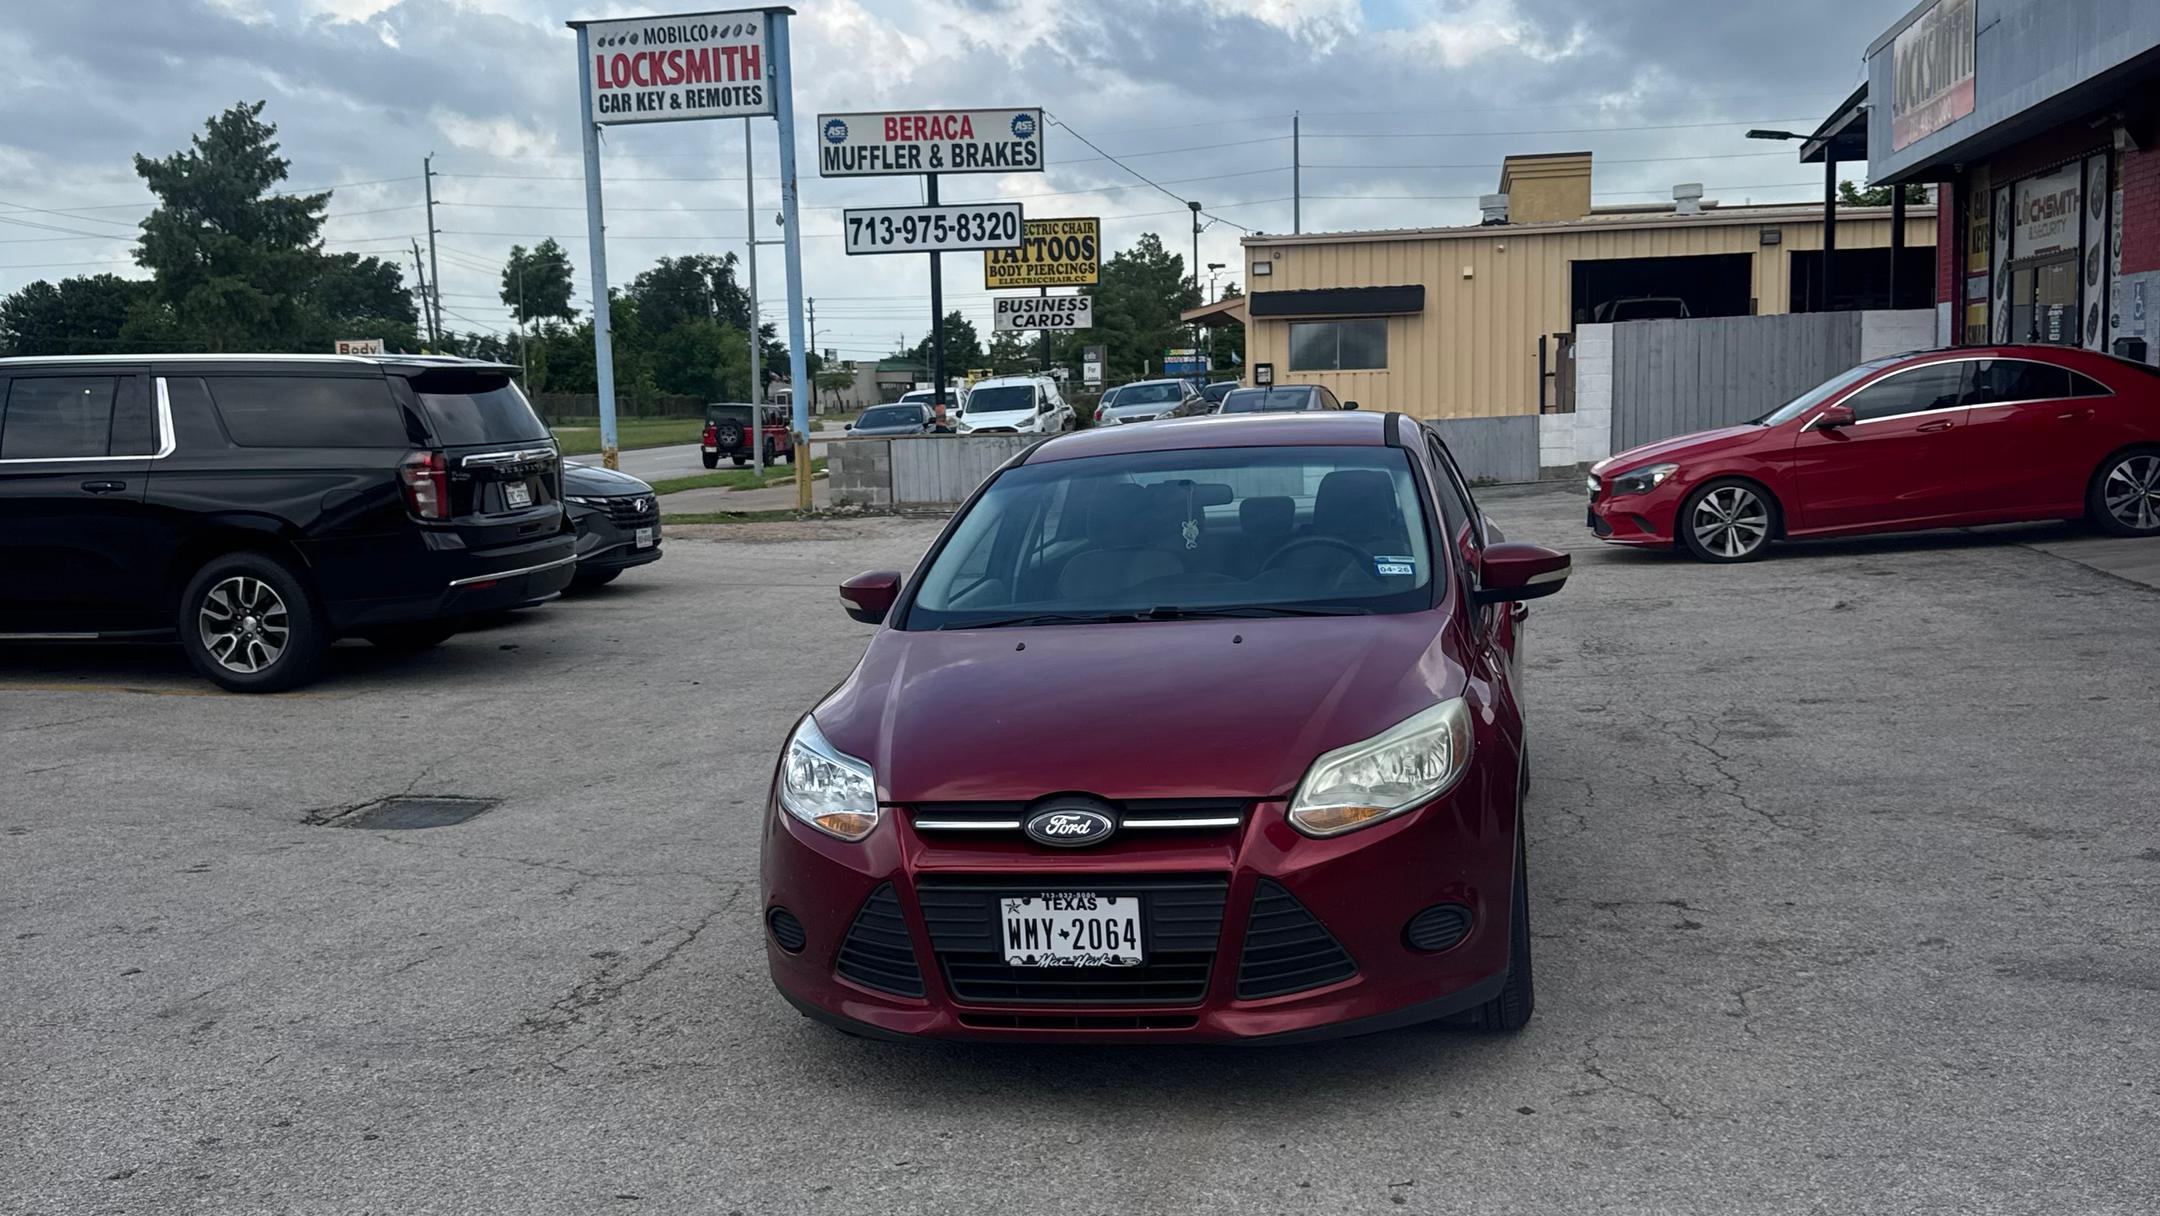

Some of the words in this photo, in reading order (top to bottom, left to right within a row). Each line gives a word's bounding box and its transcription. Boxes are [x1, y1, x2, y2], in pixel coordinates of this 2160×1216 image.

[643, 24, 708, 45] MOBILCO
[596, 45, 761, 89] LOCKSMITH
[599, 93, 632, 113] CAR
[636, 91, 665, 111] KEY
[669, 93, 682, 109] &
[686, 85, 763, 109] REMOTES
[826, 126, 847, 136] ASE
[884, 114, 974, 142] BERACA
[1014, 121, 1036, 132] ASE
[824, 144, 921, 171] MUFFLER
[929, 144, 944, 168] &
[951, 141, 1037, 167] BRAKES
[849, 211, 1017, 246] 713-975-8320
[1023, 223, 1059, 235] ECTRIC
[1062, 222, 1094, 234] CHAIR
[989, 265, 1024, 277] BODY
[1026, 262, 1095, 276] PIERCINGS
[999, 276, 1087, 285] ELECTRICCHAIR.CC
[998, 298, 1089, 313] BUSINESS
[1012, 313, 1075, 328] CARDS
[340, 343, 377, 355] Body
[1045, 815, 1091, 834] Ford
[1042, 898, 1098, 911] TEXAS
